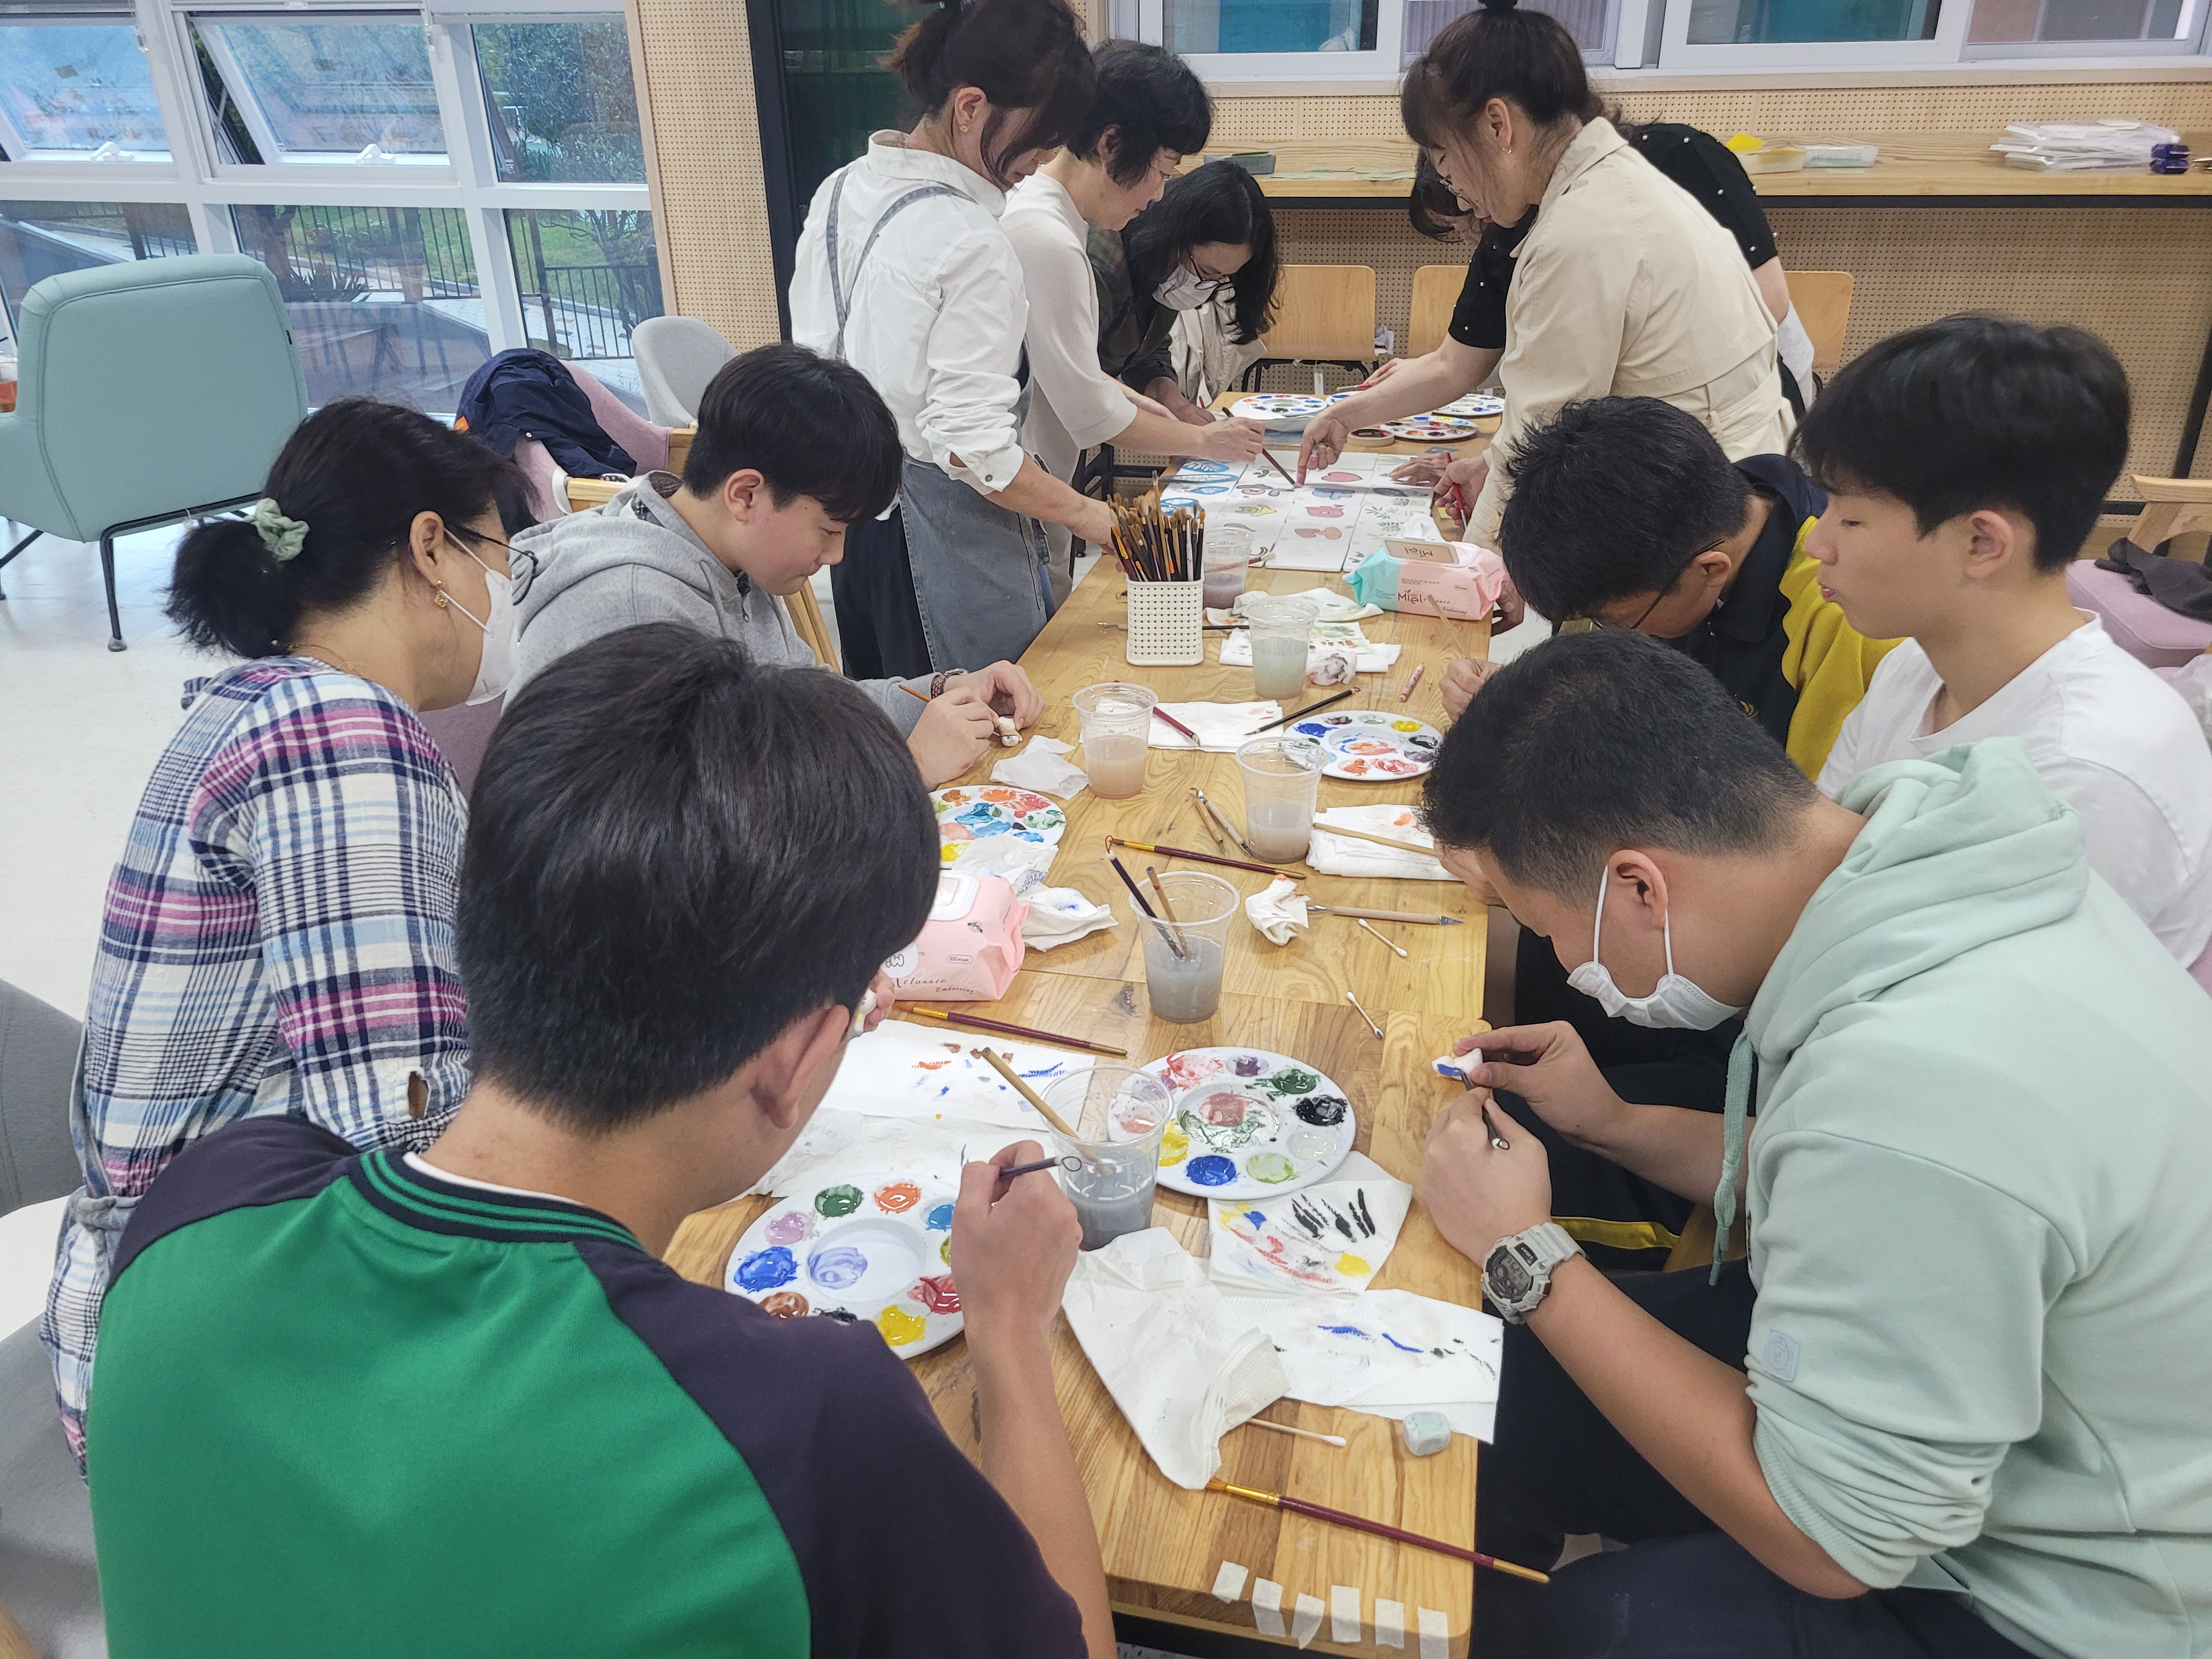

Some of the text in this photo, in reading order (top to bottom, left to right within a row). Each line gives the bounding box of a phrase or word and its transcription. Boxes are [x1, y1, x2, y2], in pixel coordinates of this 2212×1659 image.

[1404, 548, 1433, 557] Miel
[1398, 591, 1423, 604] Miel
[904, 977, 946, 985] classic
[935, 985, 974, 995] Embossing
